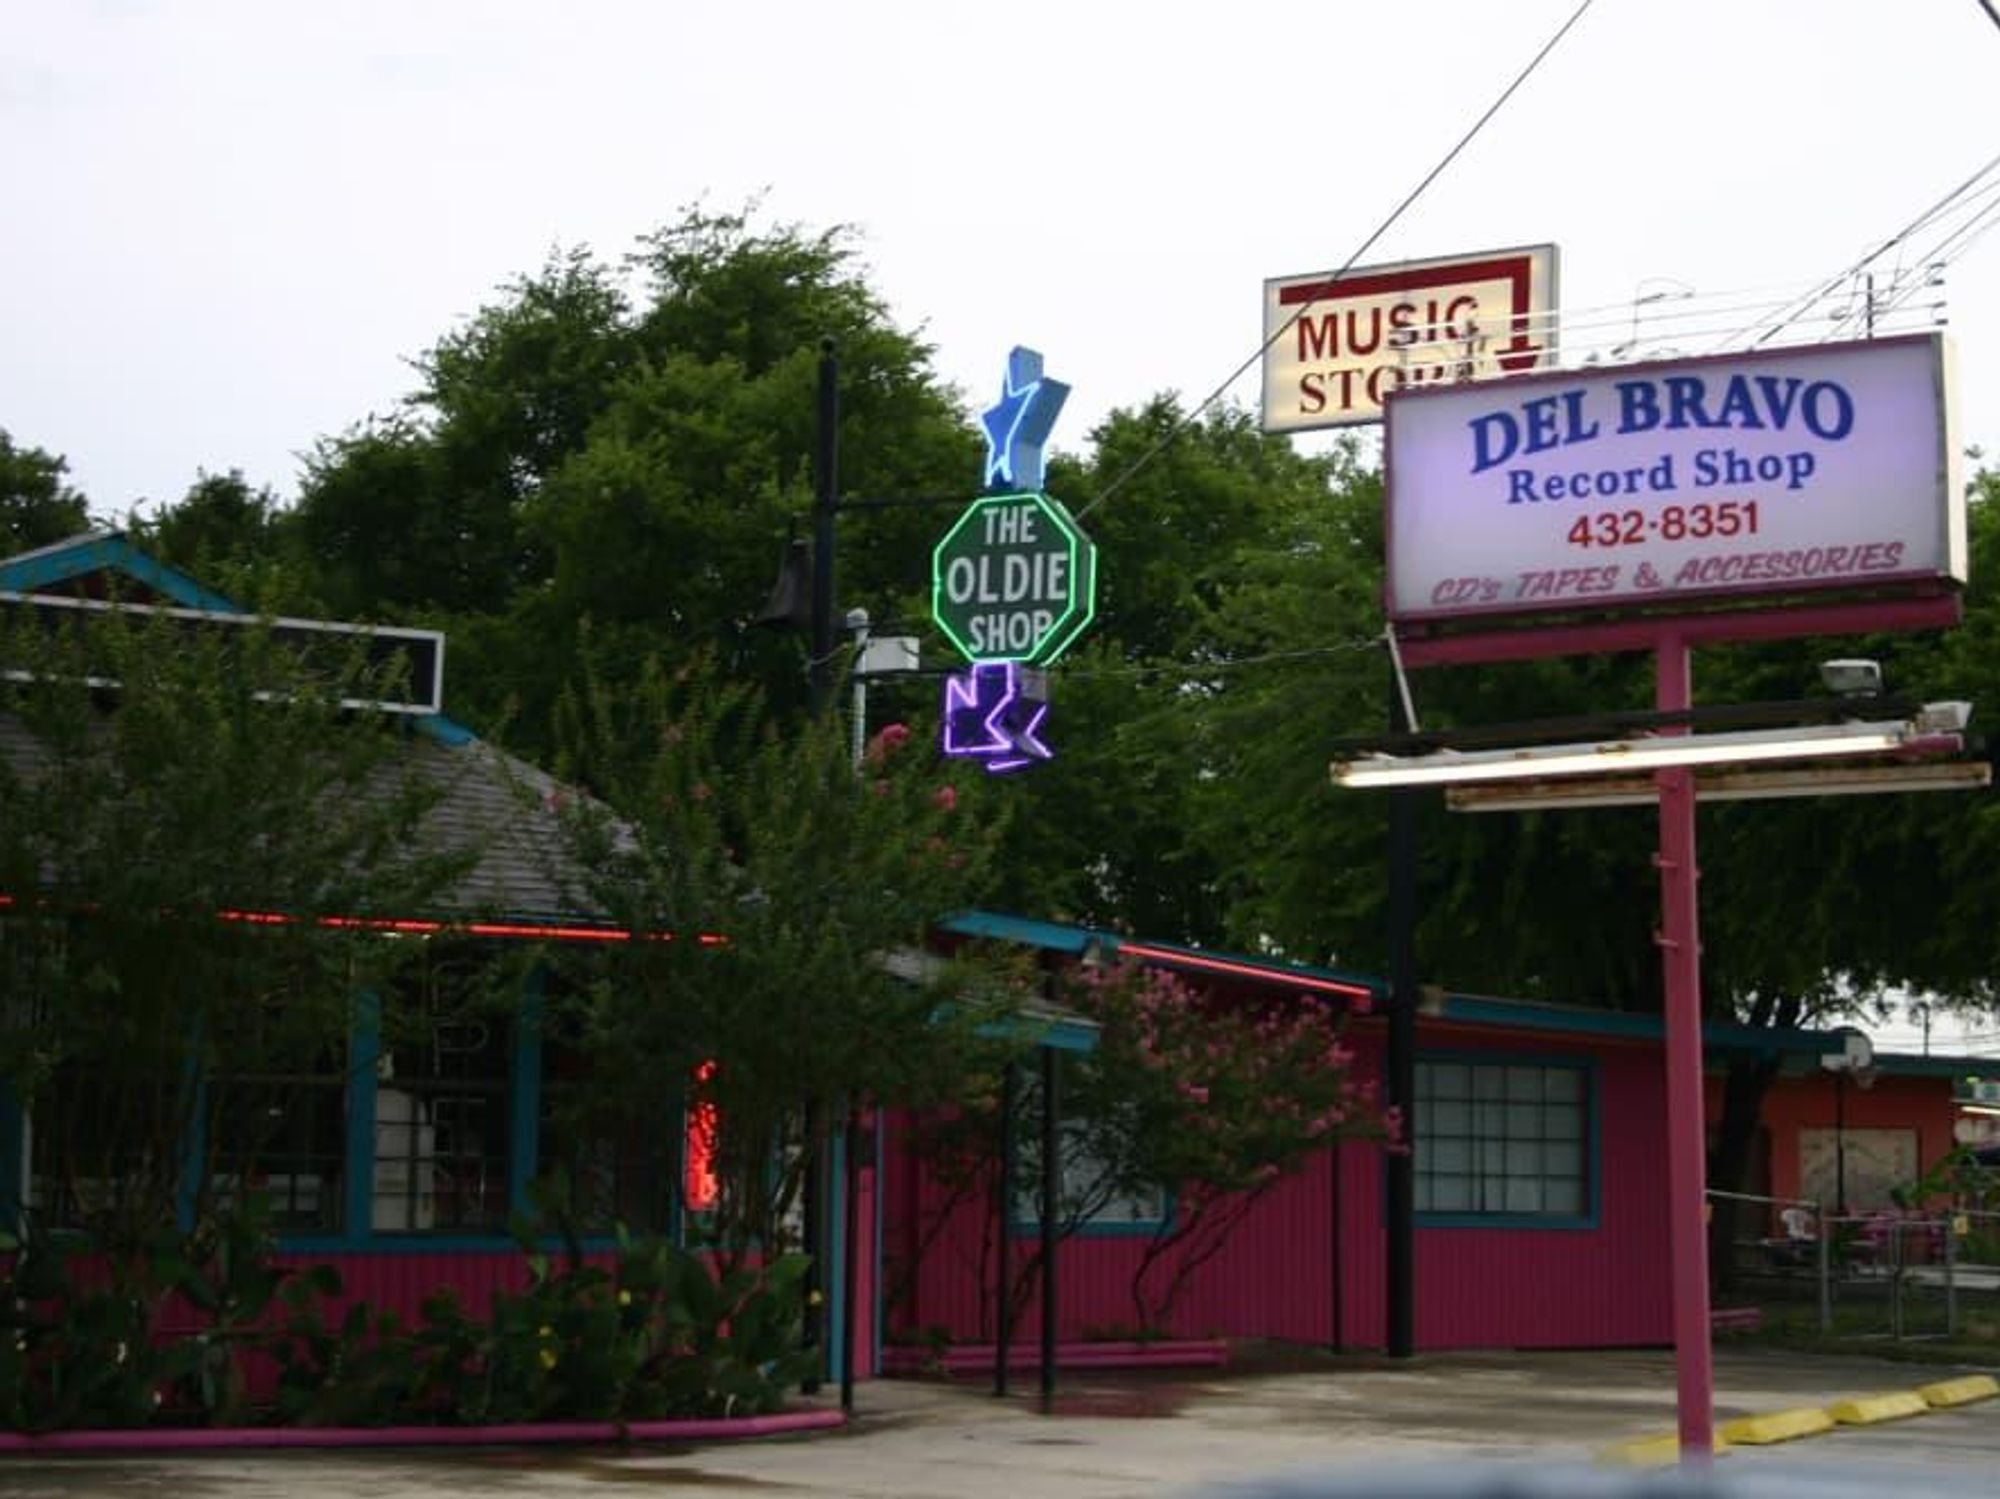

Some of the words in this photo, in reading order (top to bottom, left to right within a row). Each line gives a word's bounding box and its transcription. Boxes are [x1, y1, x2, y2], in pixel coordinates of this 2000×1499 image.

[1298, 295, 1479, 362] MUSIC
[1468, 389, 1599, 474] DEL
[1615, 374, 1855, 441] BRAVO
[1508, 453, 1677, 504] Record
[1695, 448, 1815, 489] Shop
[983, 505, 1039, 545] THE
[947, 552, 1069, 604] OLDIE
[1516, 565, 1621, 599] TAPES
[1633, 561, 1663, 588] &
[1675, 541, 1905, 586] ACCESSORIES
[968, 609, 1053, 653] SHOP
